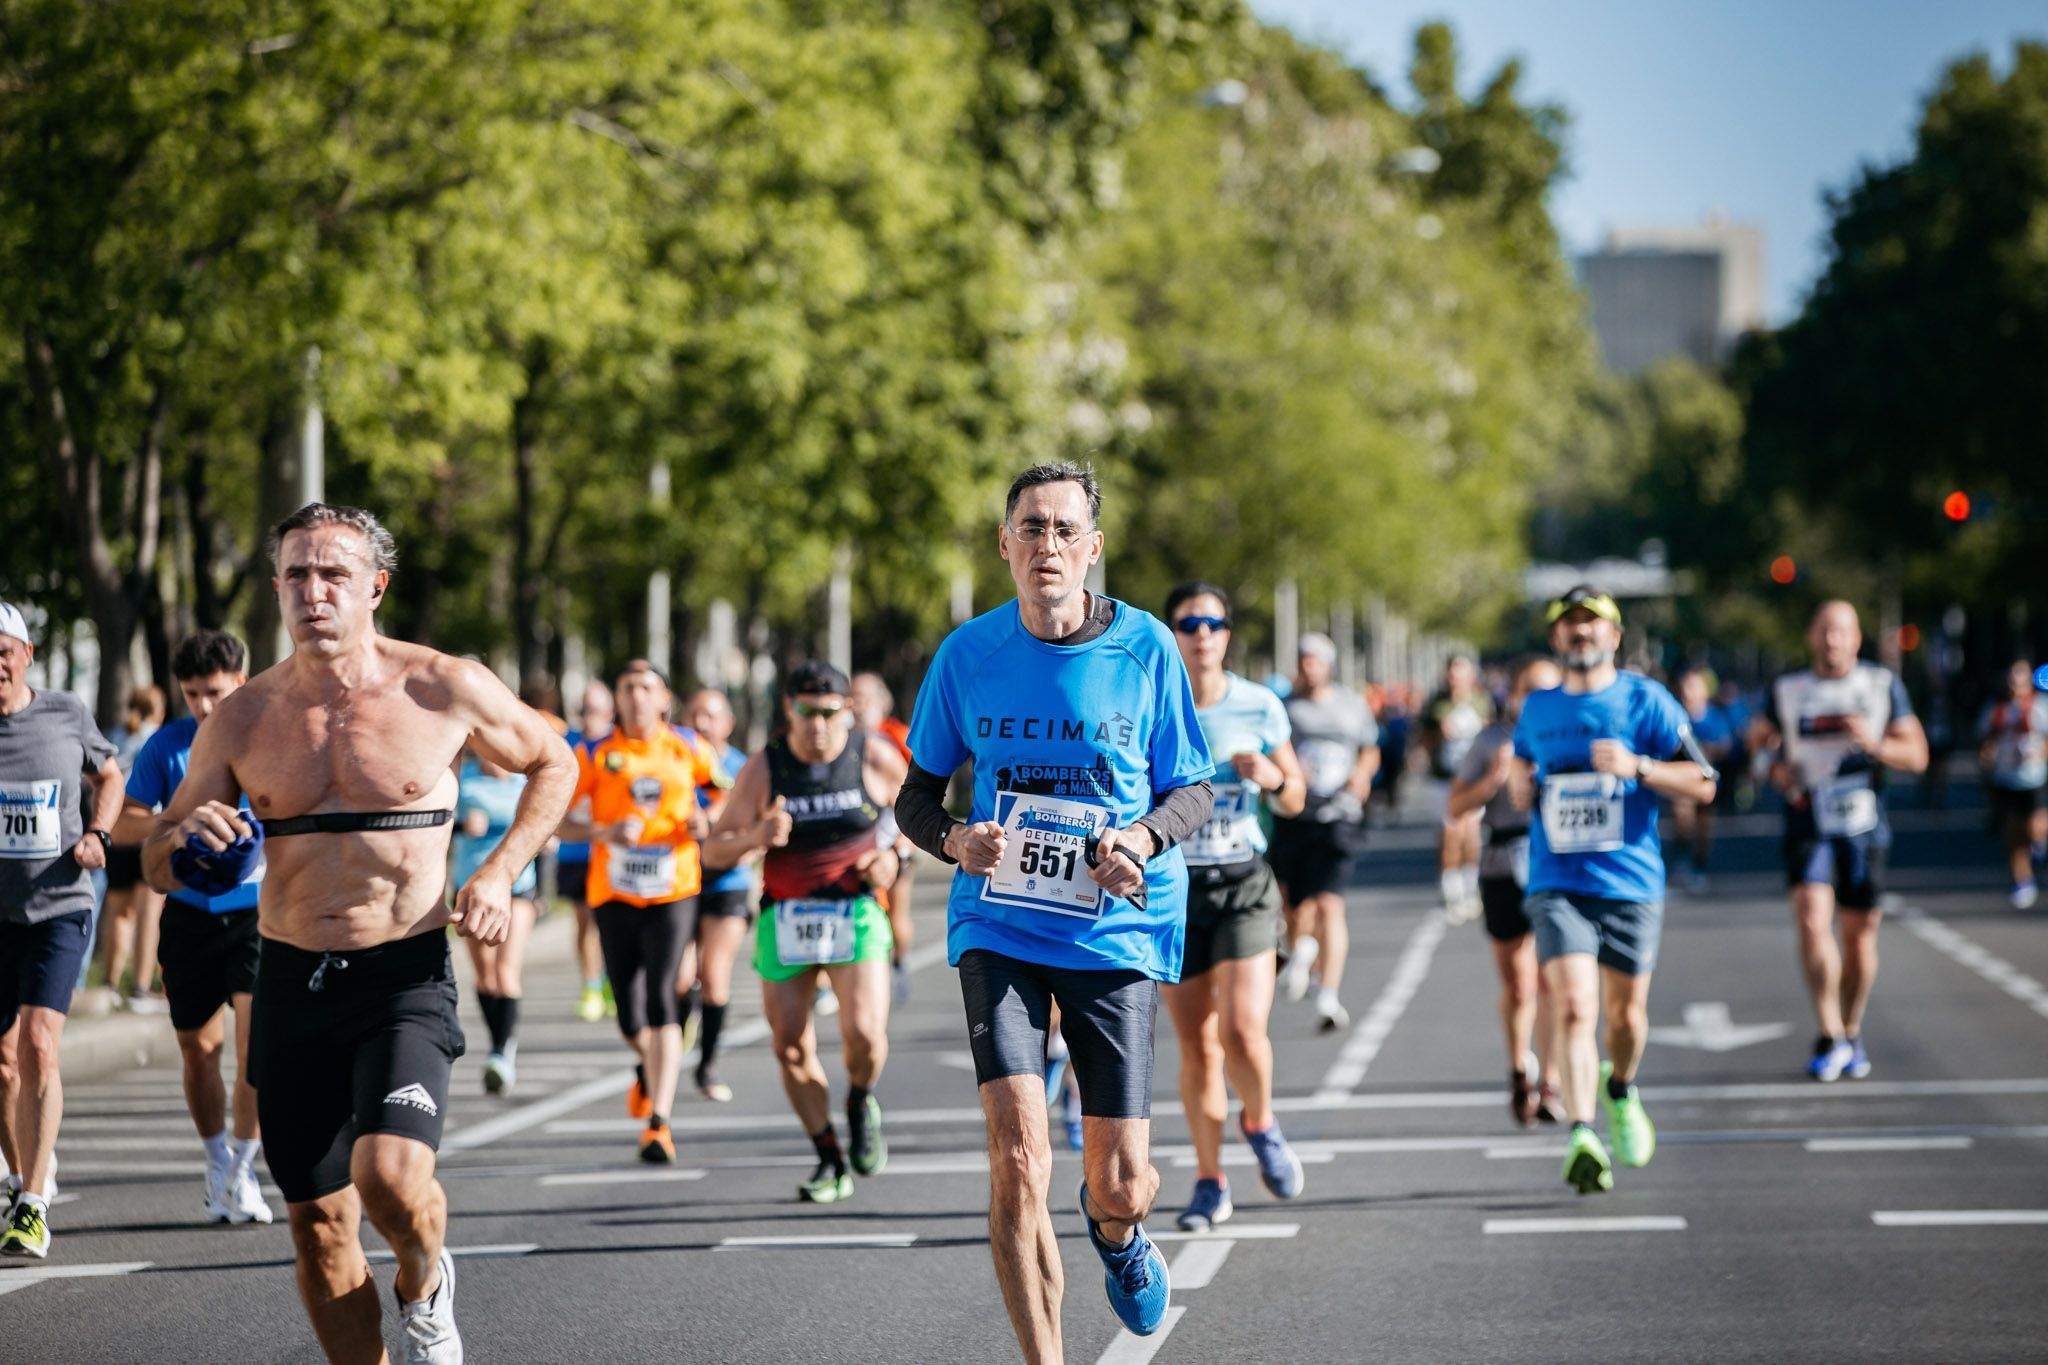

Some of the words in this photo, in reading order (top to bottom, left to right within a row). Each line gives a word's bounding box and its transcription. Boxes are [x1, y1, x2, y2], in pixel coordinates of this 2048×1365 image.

[978, 717, 1133, 747] DECIMAS
[1021, 766, 1111, 781] BOMBEROS
[1054, 781, 1067, 794] de
[1070, 782, 1110, 796] MADRID
[3, 814, 37, 836] 701
[1035, 812, 1093, 829] BOMBEROS
[1025, 830, 1086, 848] DECIMAS
[1020, 842, 1077, 881] 551
